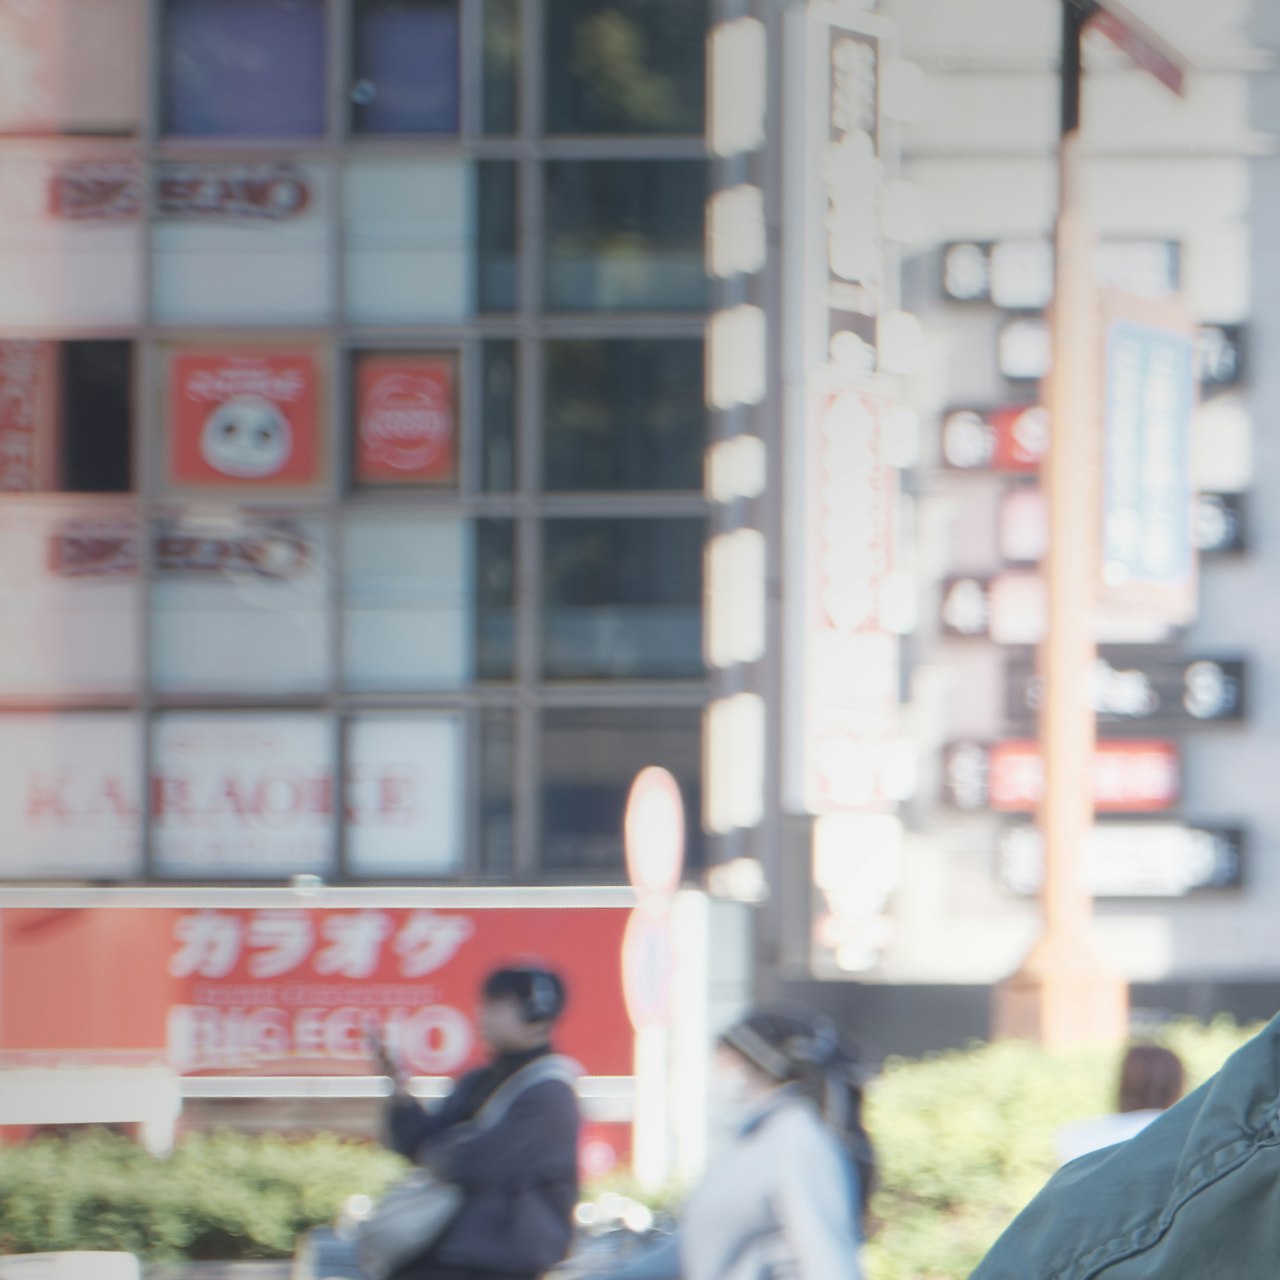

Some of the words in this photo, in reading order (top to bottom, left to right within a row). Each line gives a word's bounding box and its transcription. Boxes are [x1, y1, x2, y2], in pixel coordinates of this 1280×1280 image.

[168, 908, 477, 979] カラオケ
[166, 1003, 290, 1070] BIG
[294, 1003, 475, 1074] ECHO
